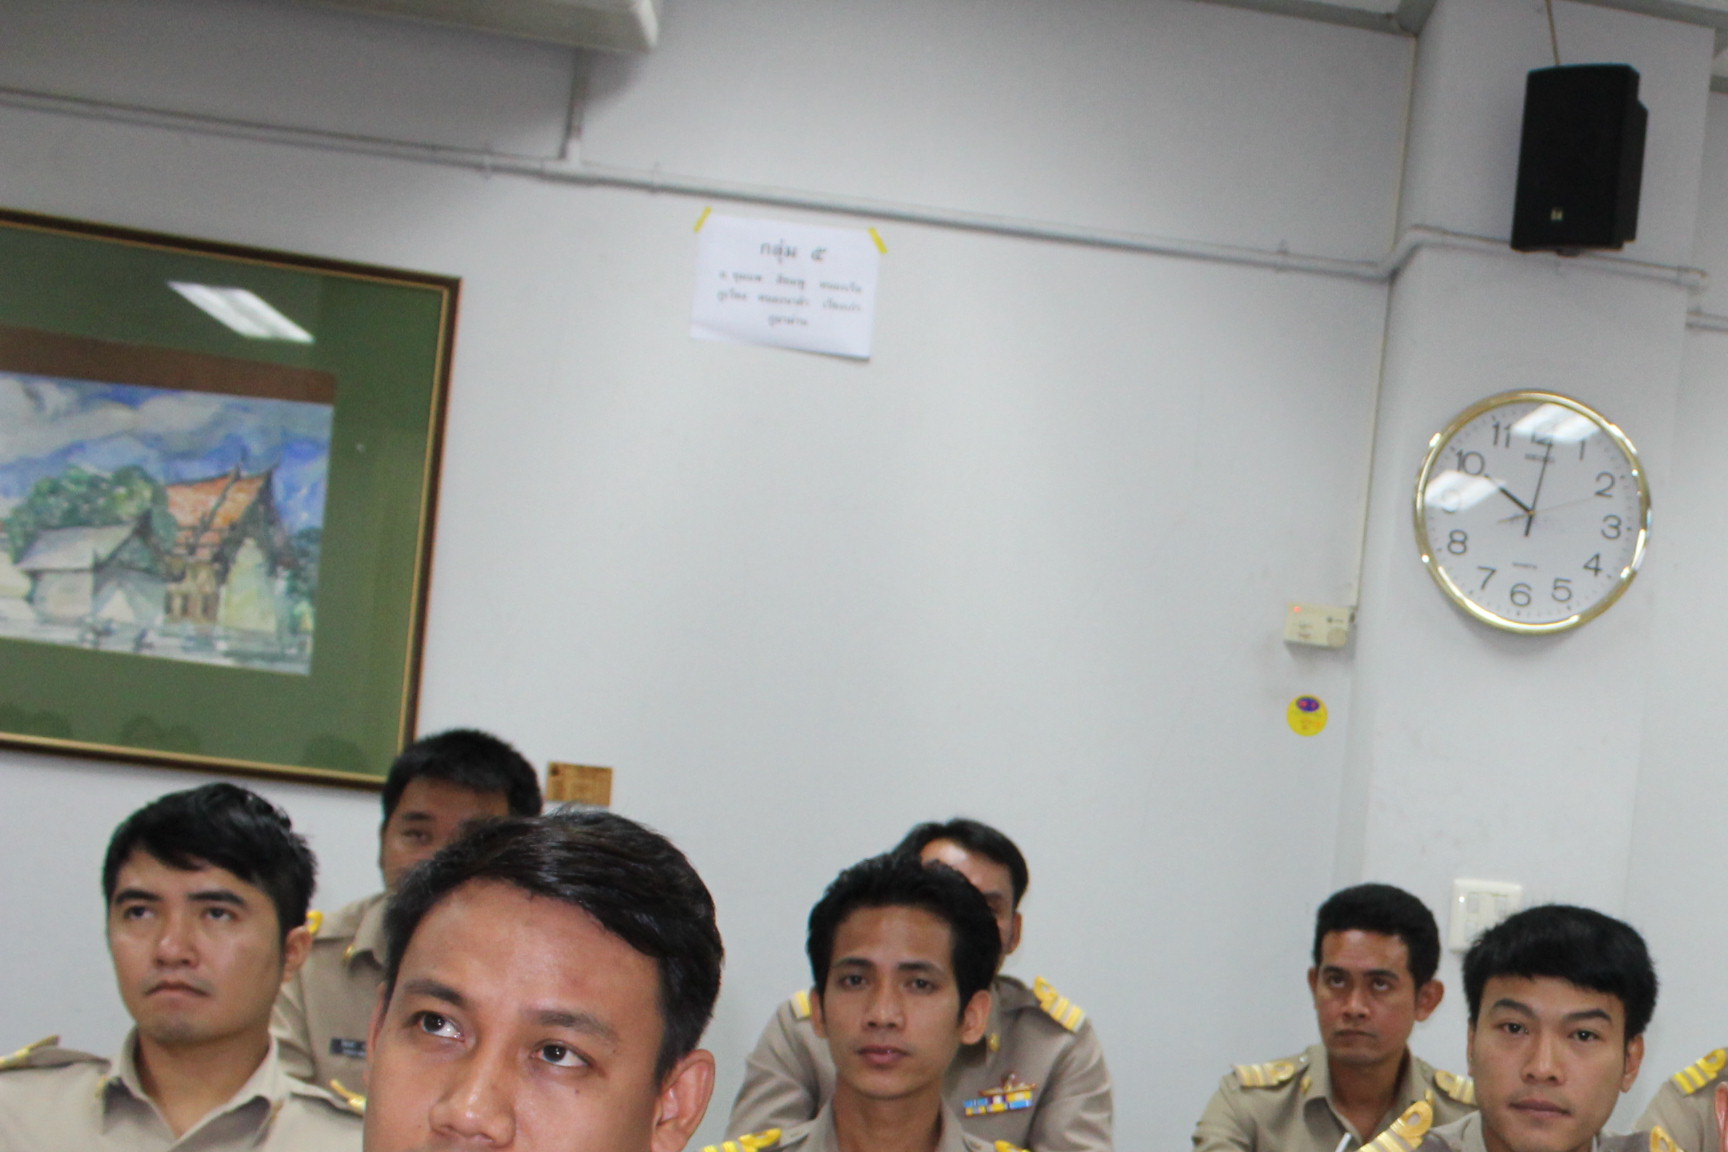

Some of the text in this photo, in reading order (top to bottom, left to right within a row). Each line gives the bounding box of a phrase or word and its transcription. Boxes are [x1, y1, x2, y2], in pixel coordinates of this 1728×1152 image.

[1492, 422, 1511, 448] 11
[1456, 450, 1485, 476] 10
[1594, 472, 1615, 498] 2
[1601, 515, 1622, 540] 3
[1447, 529, 1468, 555] 8
[1583, 553, 1603, 577] 4
[1477, 566, 1497, 590] 7
[1552, 578, 1573, 603] 5
[1509, 583, 1532, 607] 6
